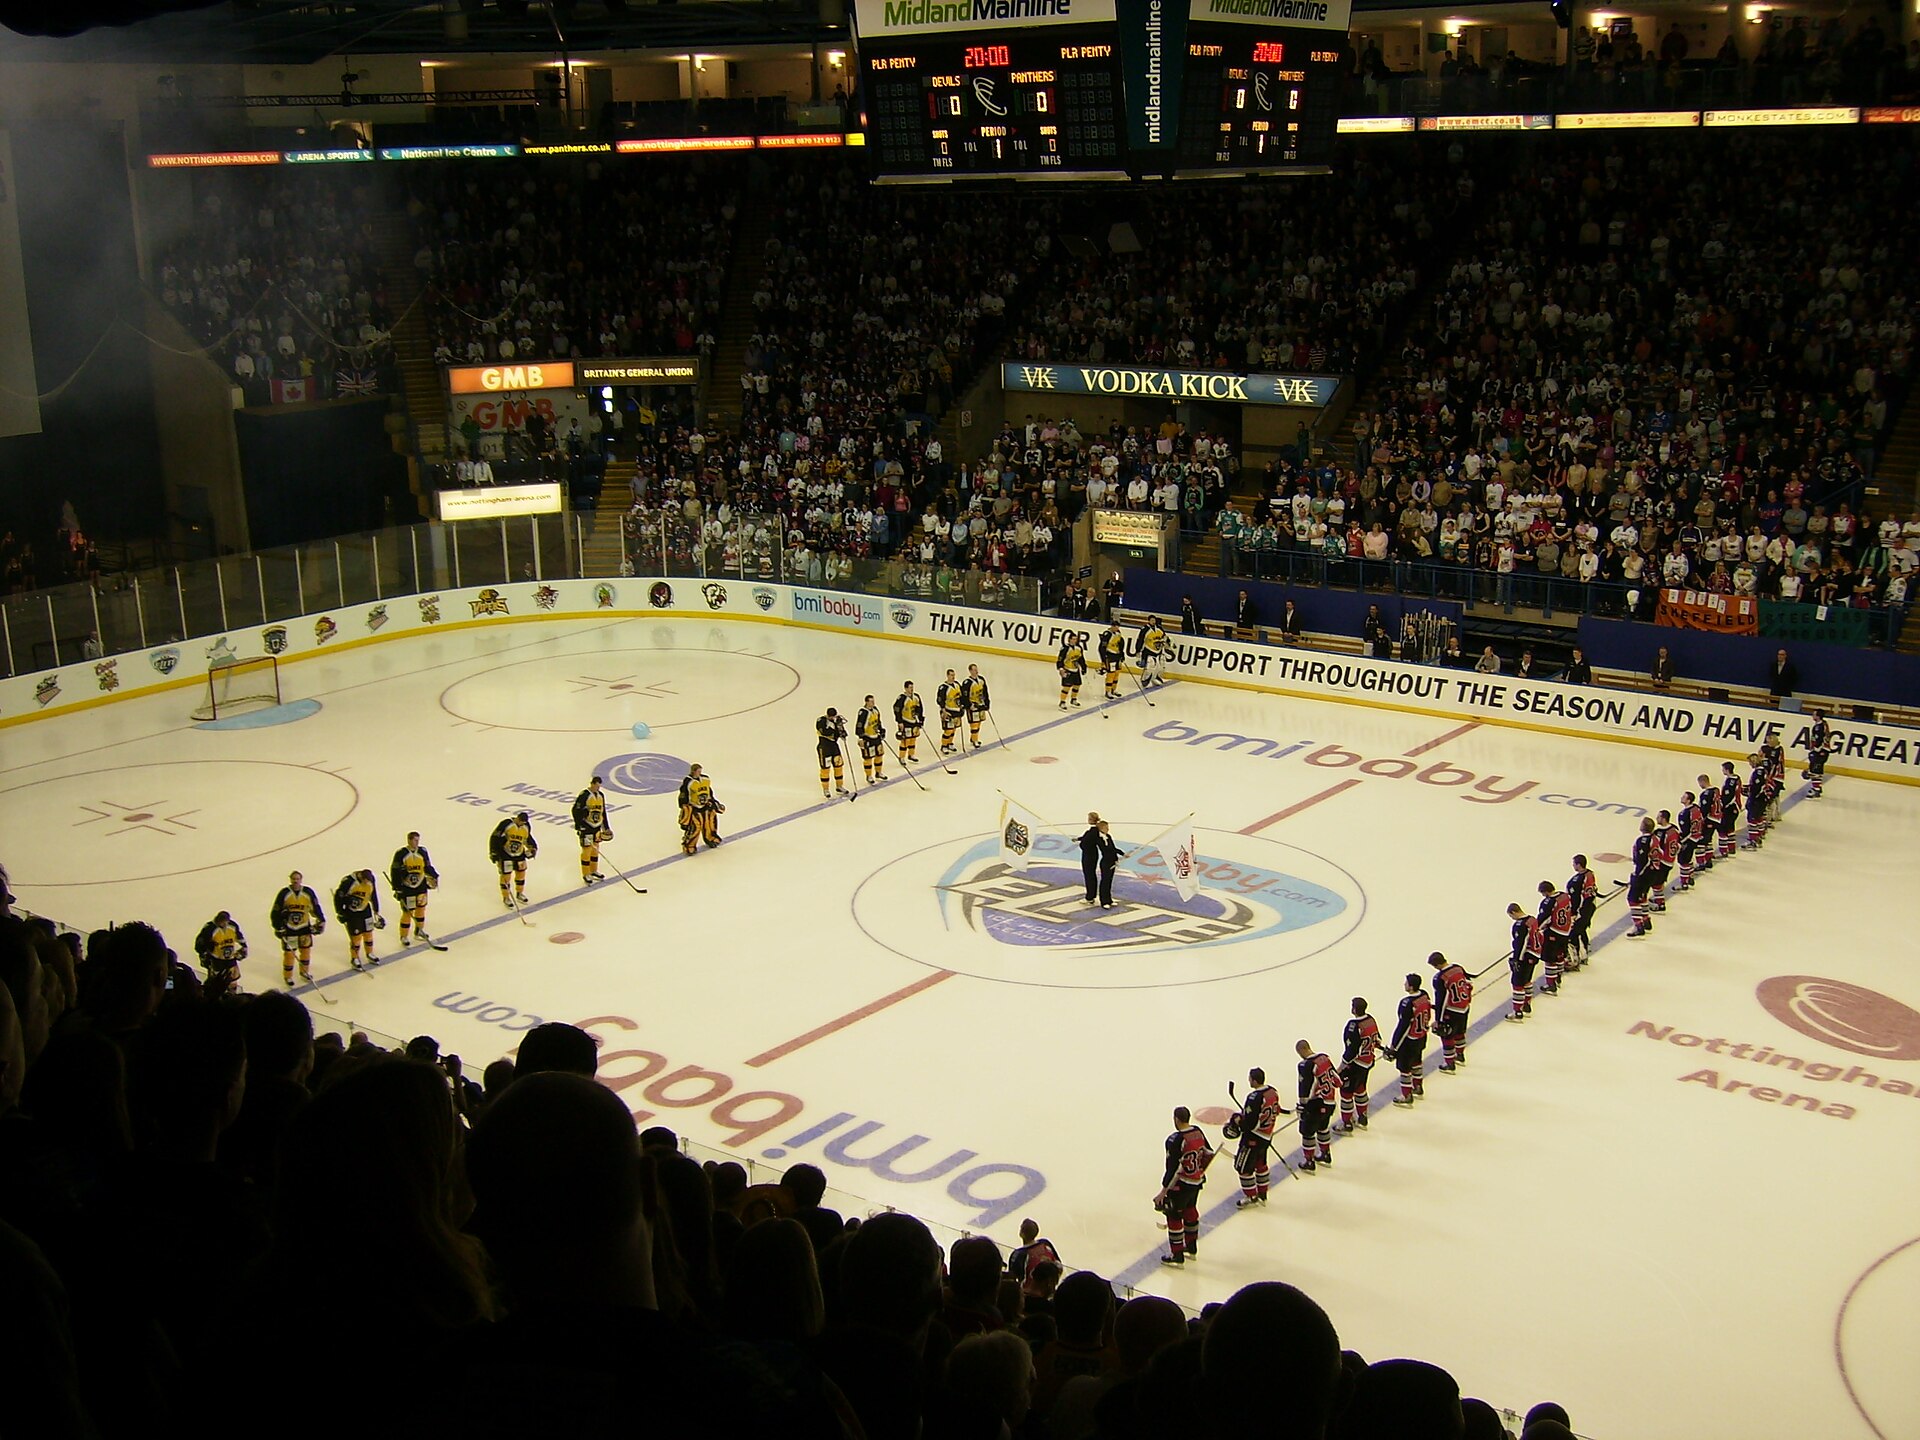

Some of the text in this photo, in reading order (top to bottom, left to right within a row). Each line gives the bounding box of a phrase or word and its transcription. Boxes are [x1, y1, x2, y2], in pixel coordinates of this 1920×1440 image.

[884, 0, 1070, 26] MidlandMainline
[965, 45, 1009, 68] 20:00
[1061, 48, 1078, 59] PLR
[1253, 43, 1283, 63] 20:00
[872, 60, 887, 70] PLR
[1145, 0, 1161, 143] midlandmainline
[932, 76, 961, 87] DEVILS
[1011, 72, 1054, 83] PANTHERS
[1717, 112, 1846, 122] MONKESTATES.COM
[981, 128, 1006, 137] PERIOD
[401, 147, 497, 158] National Ice Centre
[525, 144, 611, 153] www.panthers.co.uk
[618, 139, 755, 150] www.nottingham-arena.com
[152, 154, 279, 165] WWW.NOTTINGHAM-ARENA.COM
[297, 152, 360, 161] ARENA SPORTS
[481, 366, 544, 390] GMB
[584, 367, 693, 378] BRITAIN'S GENERAL UNION
[1022, 367, 1054, 388] VK
[1081, 369, 1248, 399] VODKA KICK
[1277, 378, 1313, 402] VK
[472, 398, 556, 430] GMB
[795, 592, 880, 624] bmibaby.com
[929, 612, 993, 640] THANK
[1002, 621, 1041, 644] YOU
[1279, 656, 1448, 699] THROUGHOUT
[1456, 682, 1507, 707] THE
[1513, 690, 1626, 725] SEASON
[1632, 705, 1694, 732] AND
[1702, 714, 1785, 744] HAVE
[1790, 726, 1810, 750] A
[1143, 720, 1647, 818] bmibaby.com
[447, 792, 576, 829] Ice Centr
[1626, 1021, 1920, 1099] Nottingha
[1677, 1069, 1857, 1120] Arena
